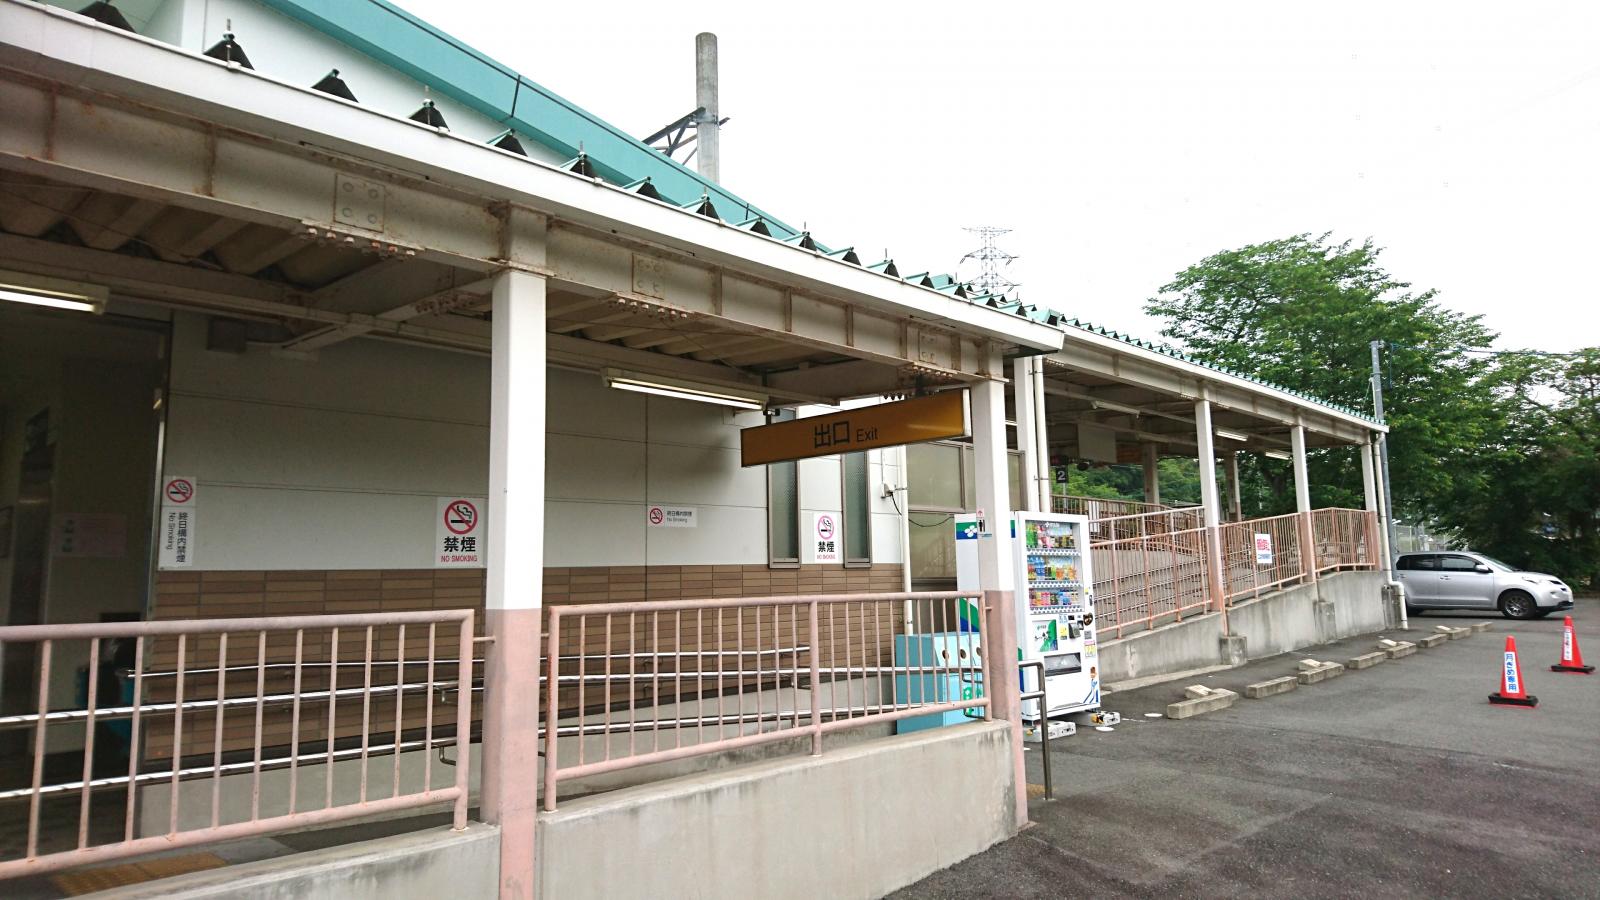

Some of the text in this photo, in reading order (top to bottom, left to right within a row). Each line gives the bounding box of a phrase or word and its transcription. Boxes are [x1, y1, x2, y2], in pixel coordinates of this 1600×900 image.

[814, 420, 879, 448] 出口 Exit
[1057, 470, 1066, 481] 2
[168, 512, 176, 522] No
[443, 536, 476, 553] 禁煙
[818, 541, 835, 553] 禁煙
